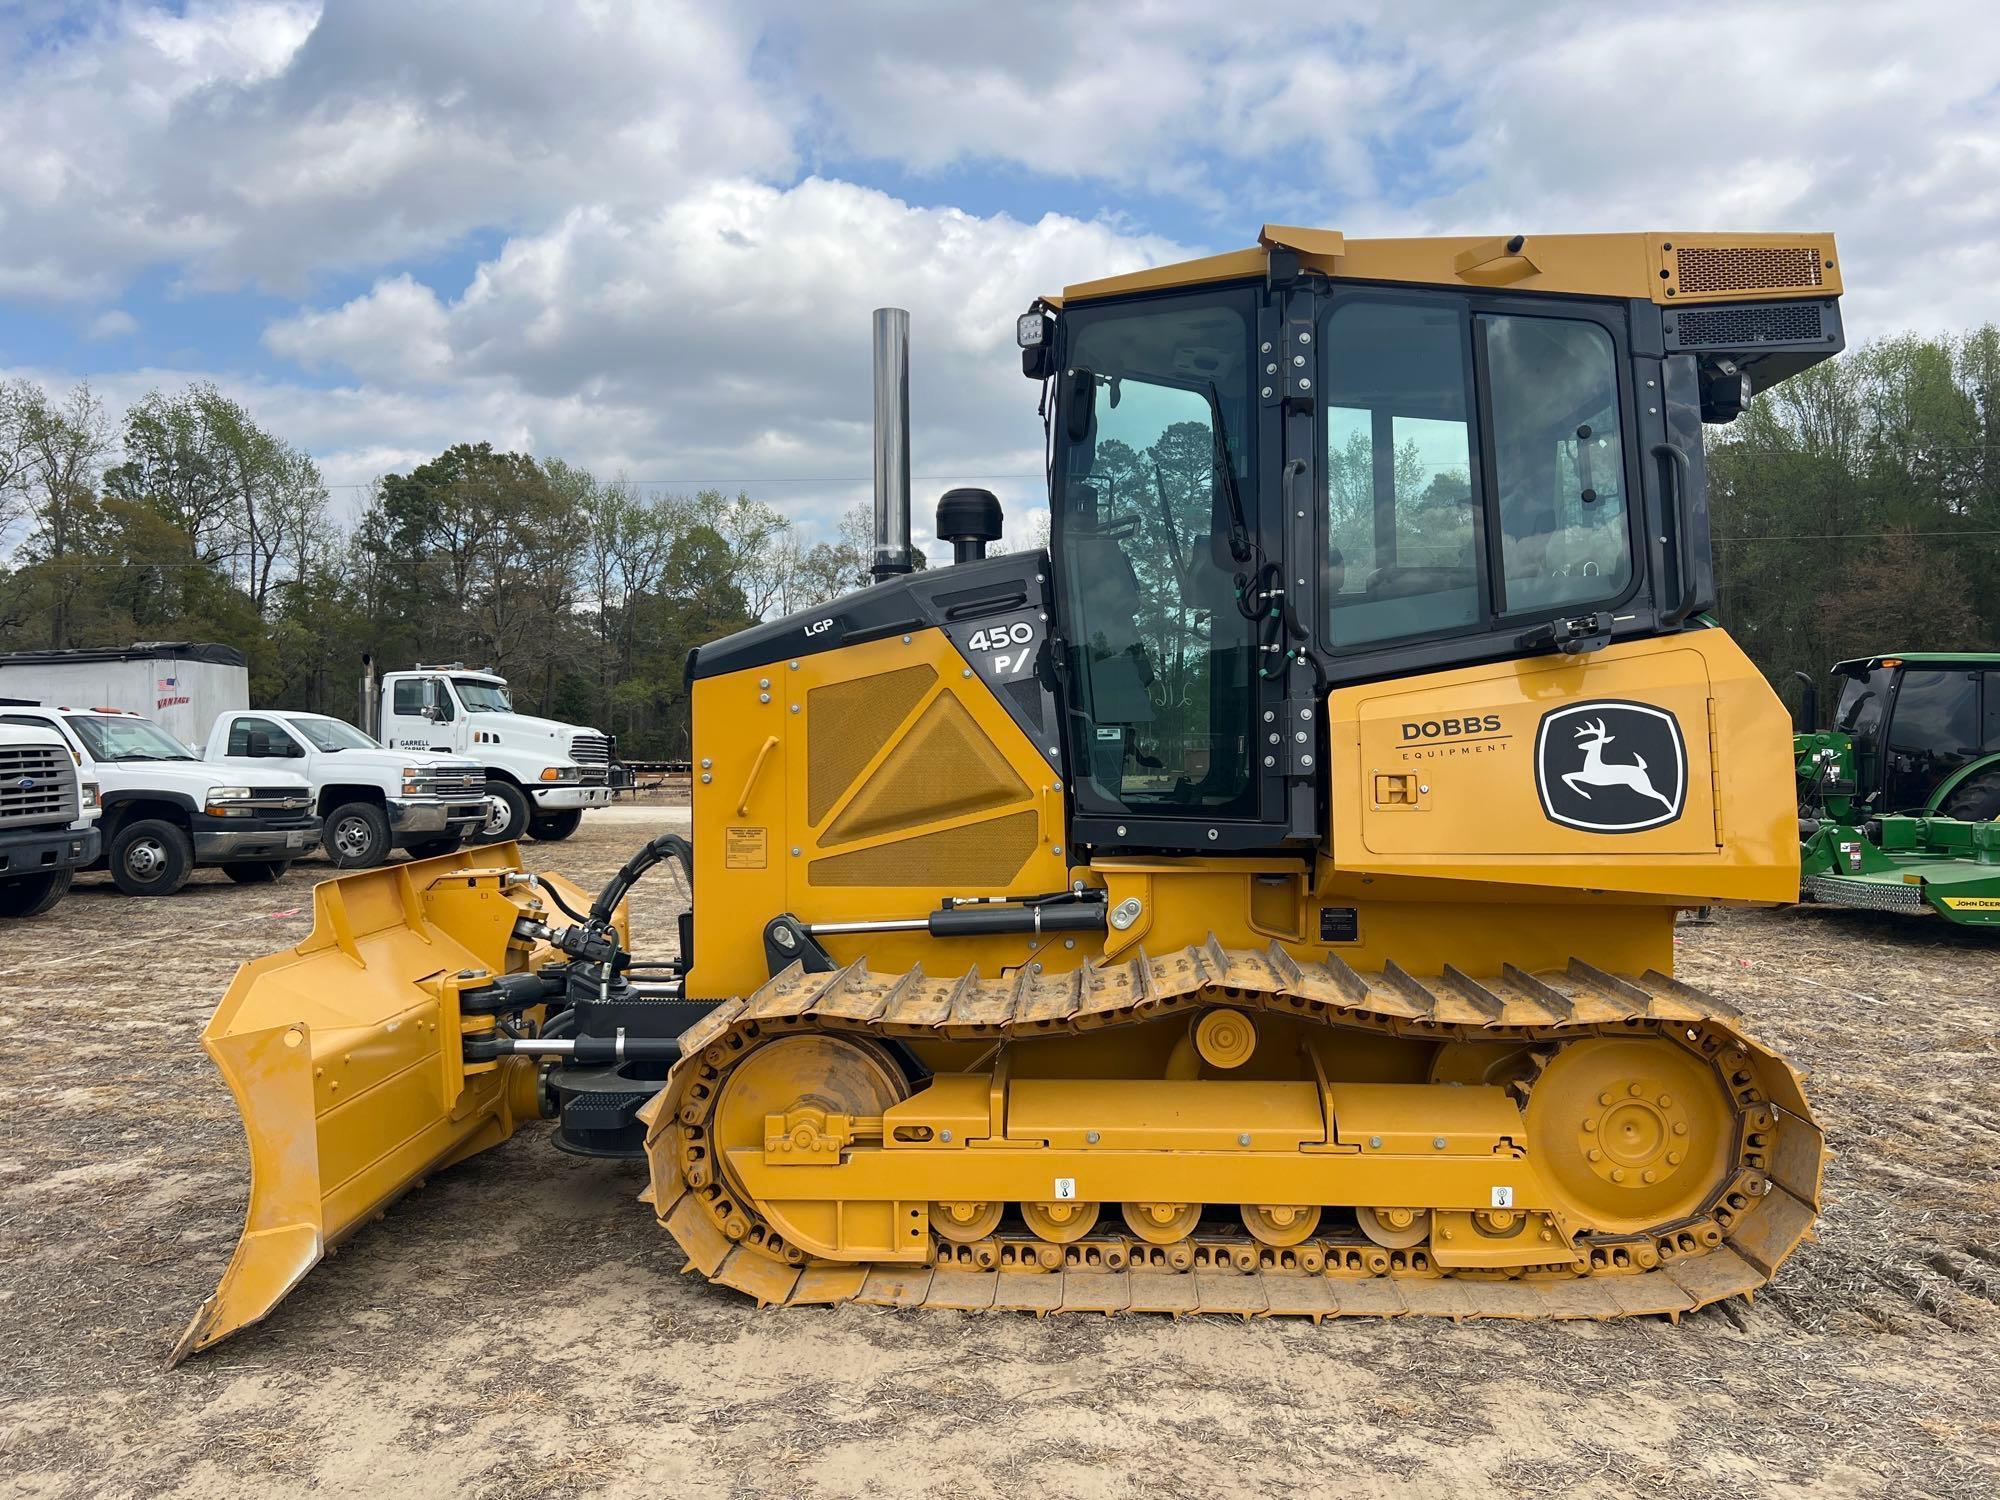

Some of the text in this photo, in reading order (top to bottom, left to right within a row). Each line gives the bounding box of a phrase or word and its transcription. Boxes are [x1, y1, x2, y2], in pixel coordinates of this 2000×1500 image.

[804, 618, 834, 637] LGP
[968, 621, 1034, 652] 450
[157, 697, 190, 709] VANTAGE
[1401, 714, 1501, 741] DOBBS
[1401, 743, 1506, 760] EQUIPMENT
